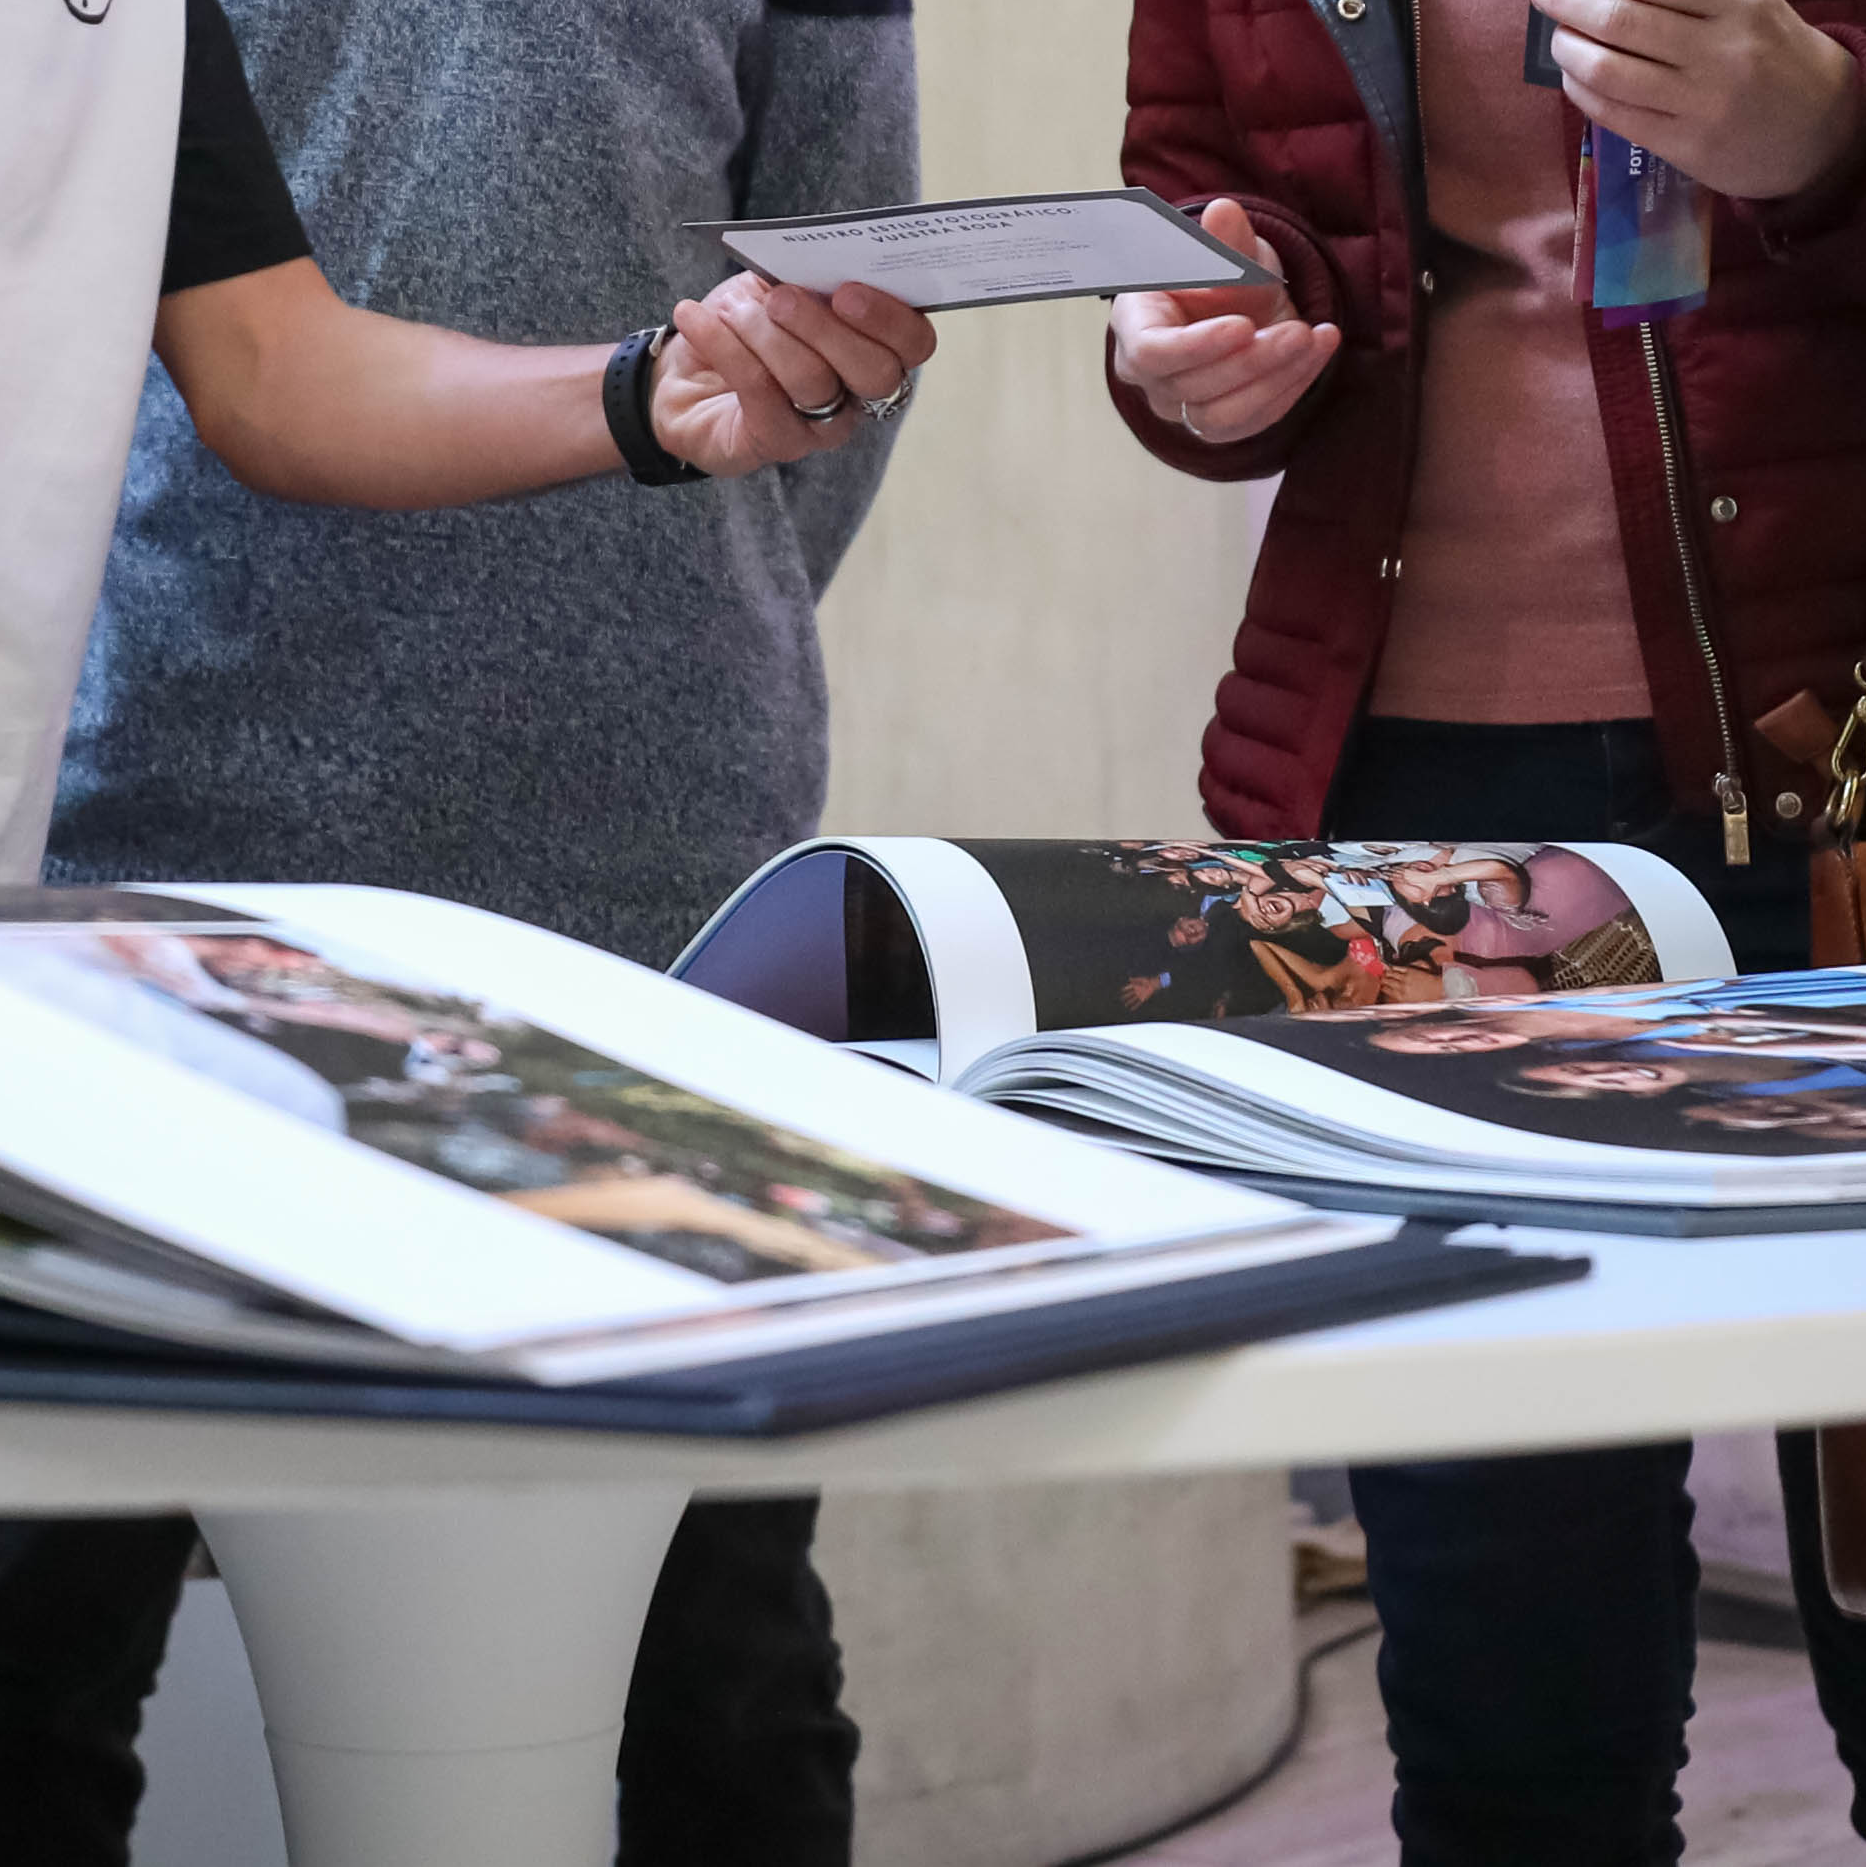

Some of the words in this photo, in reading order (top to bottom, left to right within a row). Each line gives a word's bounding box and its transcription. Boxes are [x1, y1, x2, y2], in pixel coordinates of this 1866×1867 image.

[1629, 142, 1643, 175] FOT
[783, 228, 863, 243] NUESTRO
[869, 219, 930, 234] ESTILO
[870, 226, 956, 244] VUESTRA
[962, 221, 1013, 233] BODA
